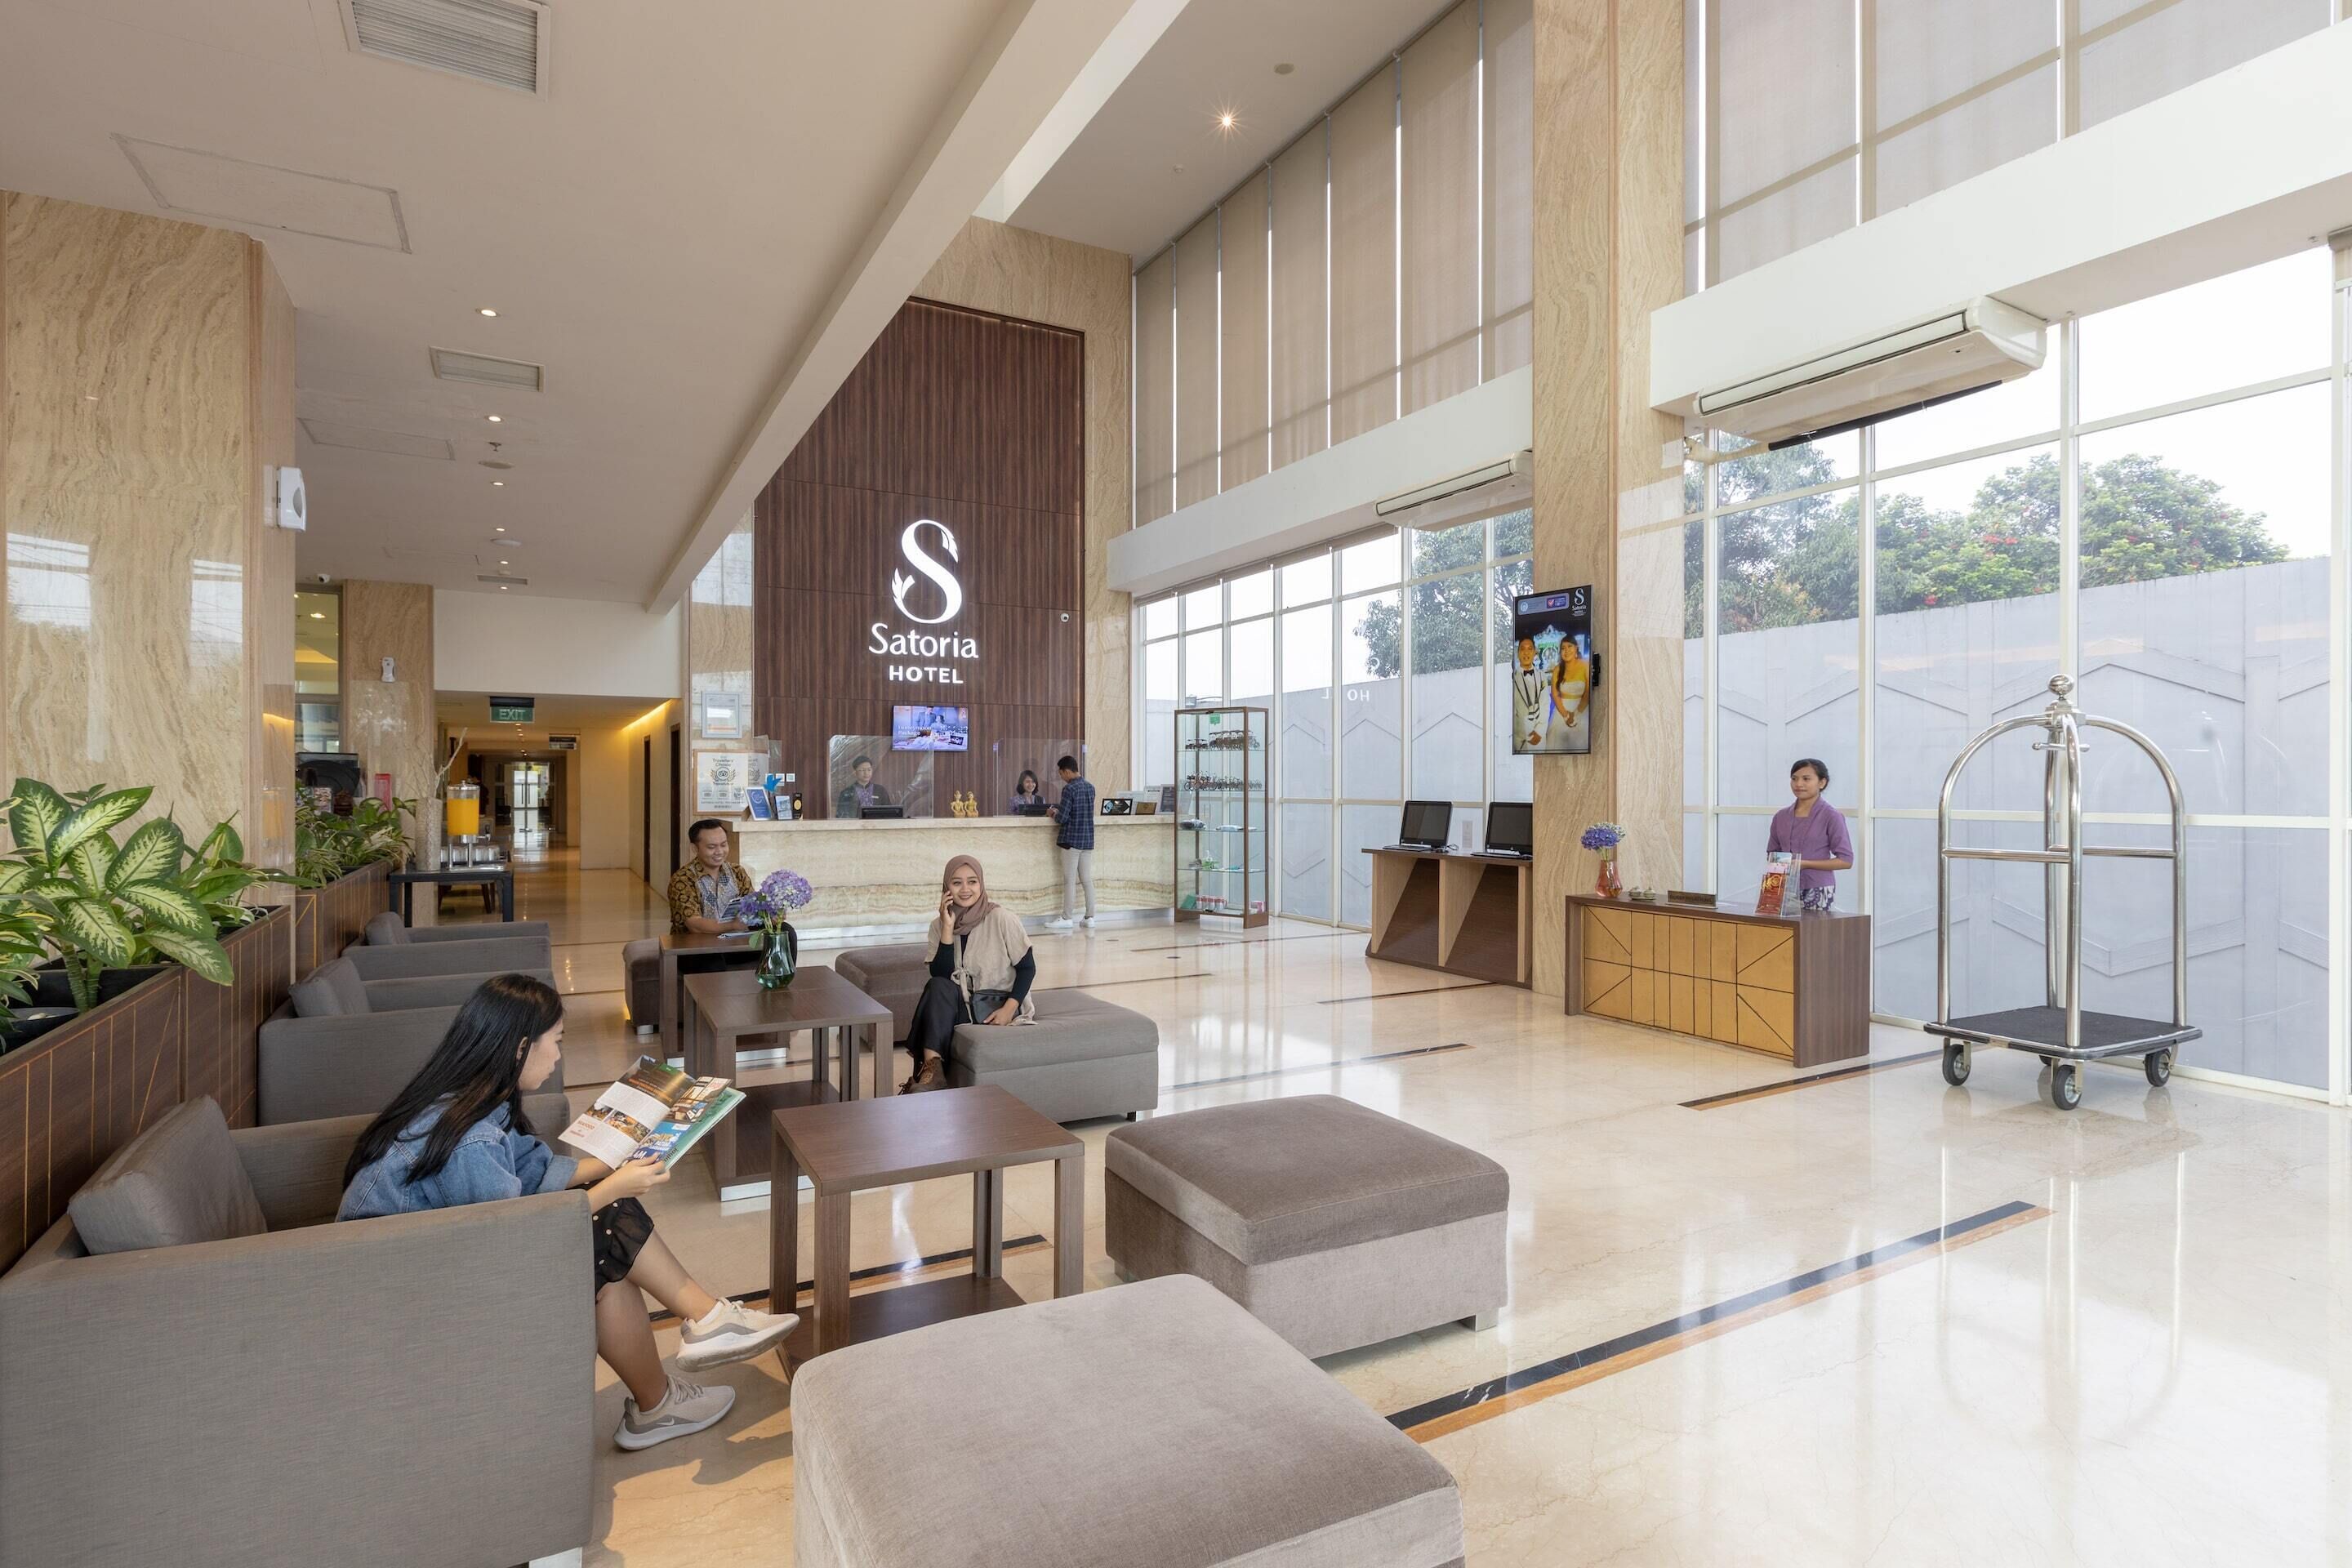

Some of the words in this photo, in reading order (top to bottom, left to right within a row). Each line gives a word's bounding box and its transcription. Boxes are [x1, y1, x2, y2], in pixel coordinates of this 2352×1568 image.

[868, 622, 979, 659] Satoria
[889, 665, 964, 684] HOTEL
[499, 708, 526, 720] EXIT
